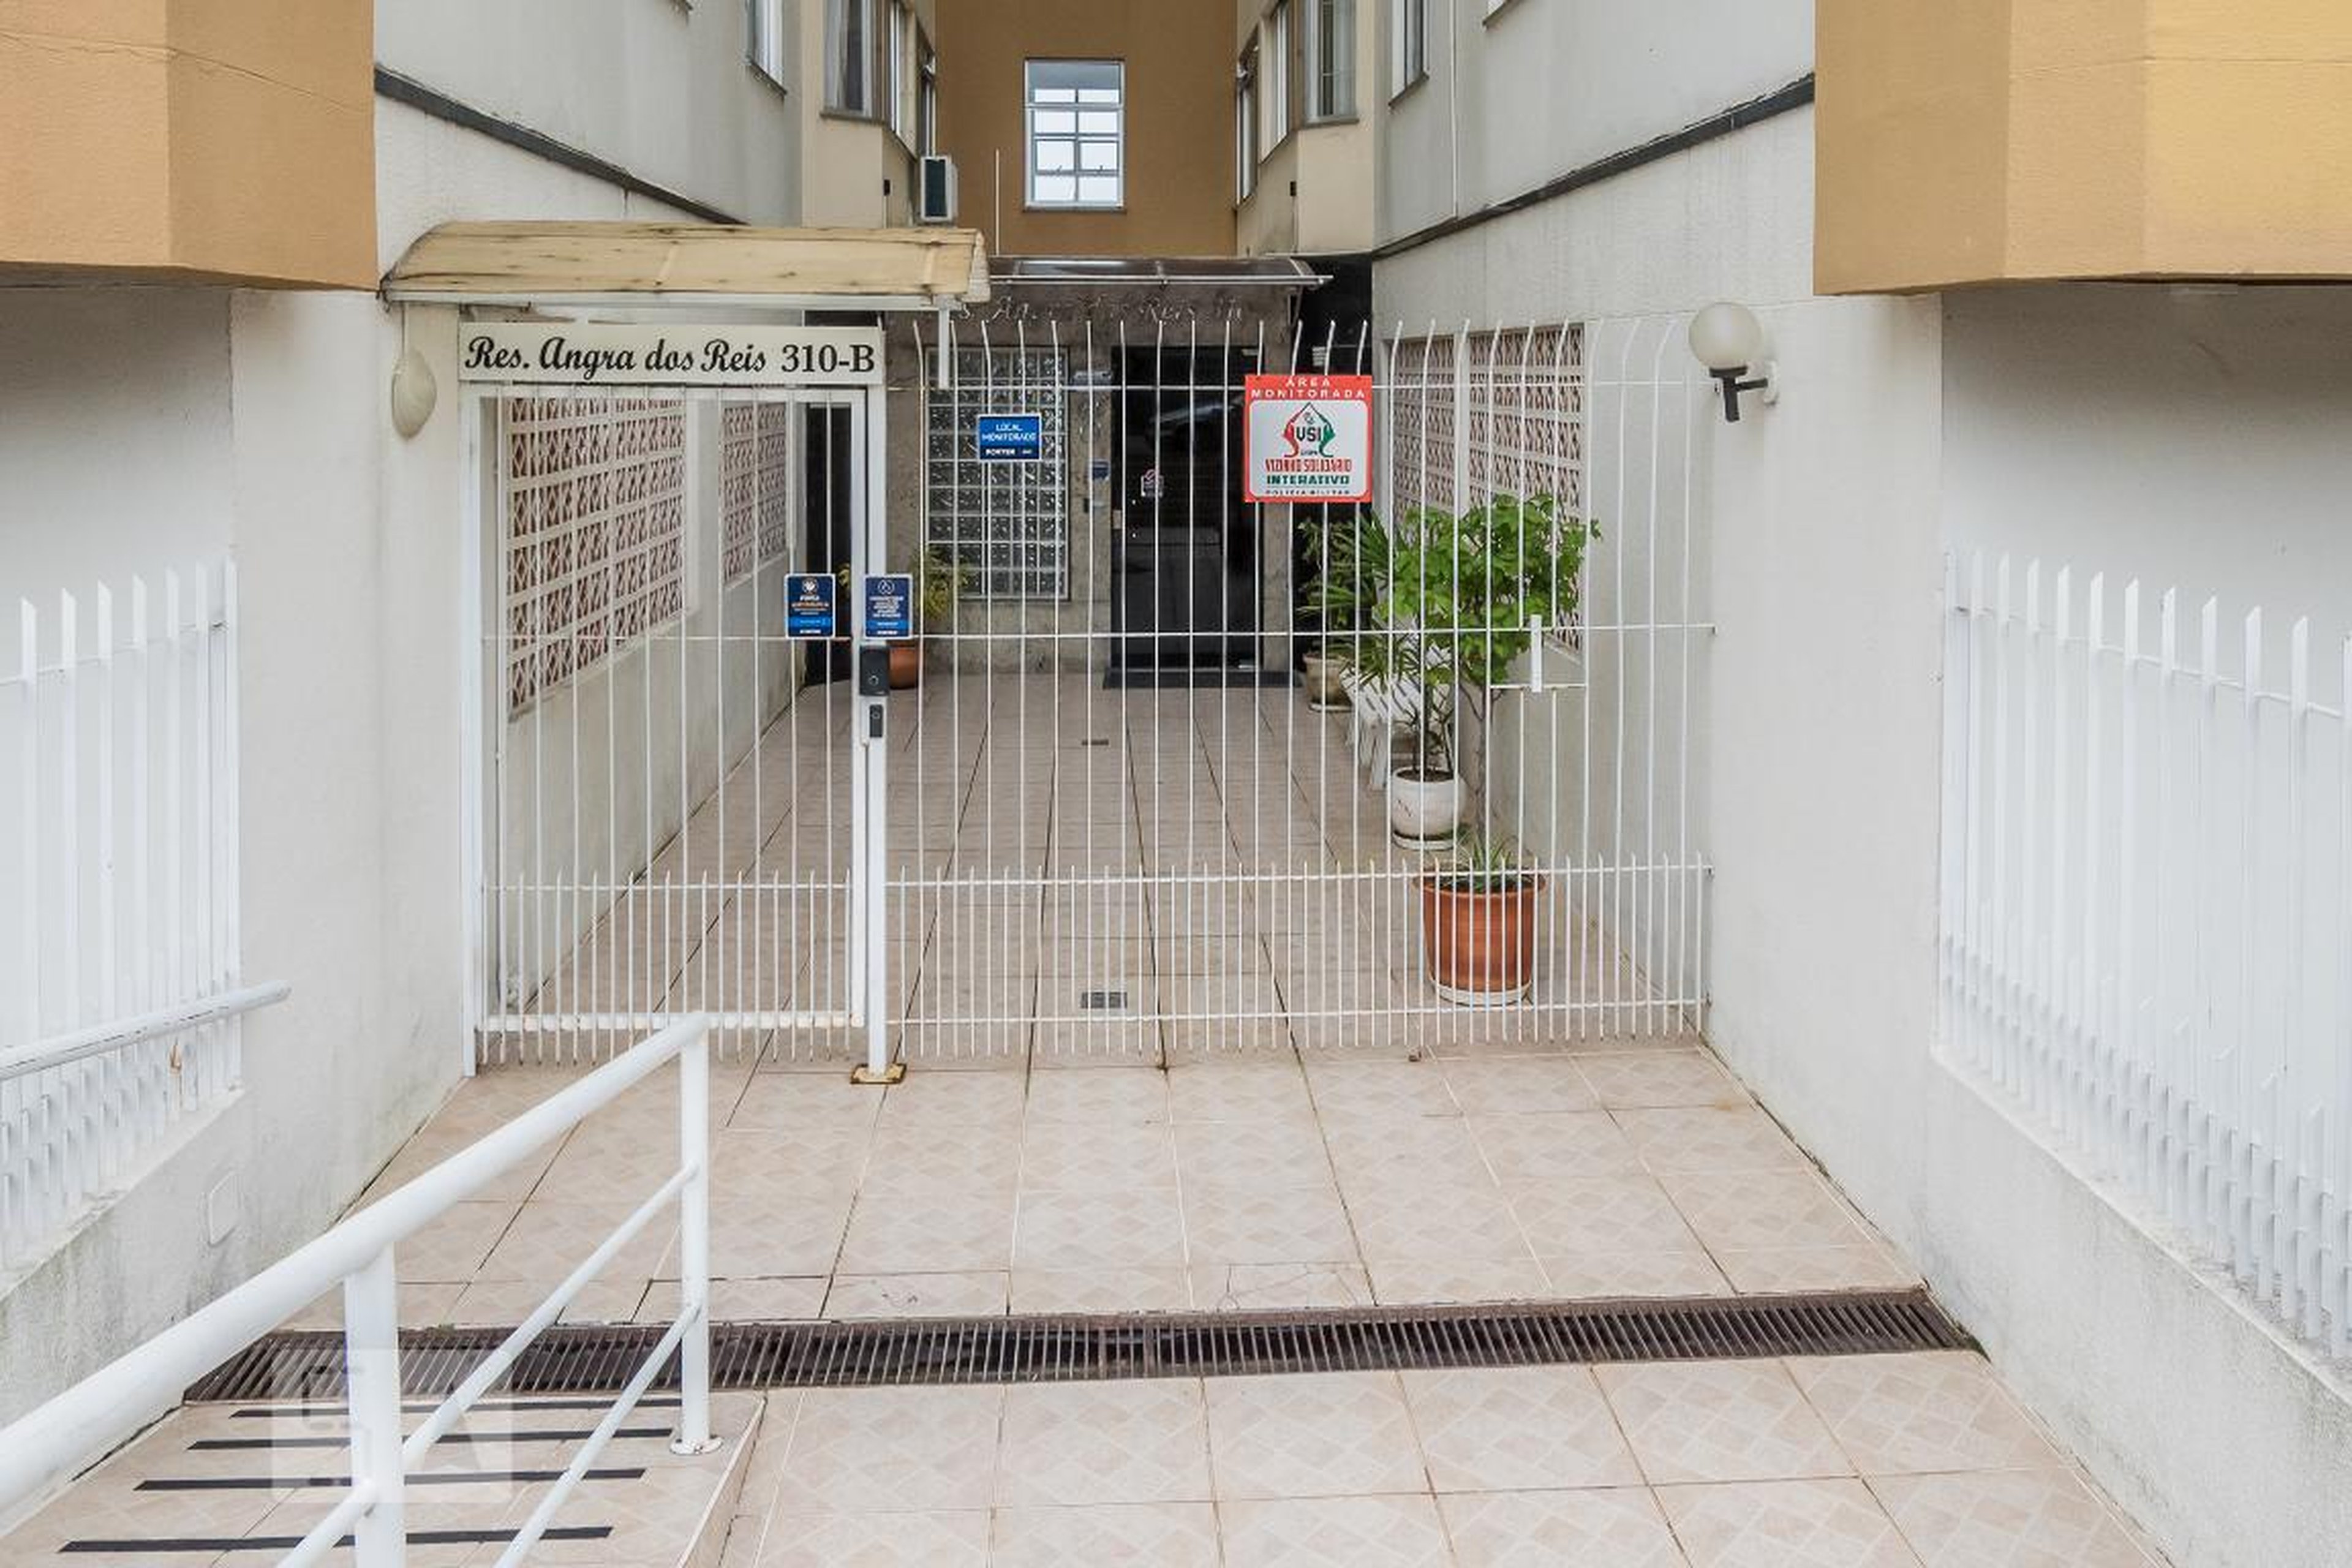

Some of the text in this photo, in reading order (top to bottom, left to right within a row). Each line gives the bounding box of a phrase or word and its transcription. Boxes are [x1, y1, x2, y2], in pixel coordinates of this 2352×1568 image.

[464, 335, 876, 380] Res. Angra dos Reis 310-B
[1251, 389, 1365, 398] MONITORADA
[1296, 426, 1321, 442] USI
[1267, 475, 1350, 484] INTERATIVO
